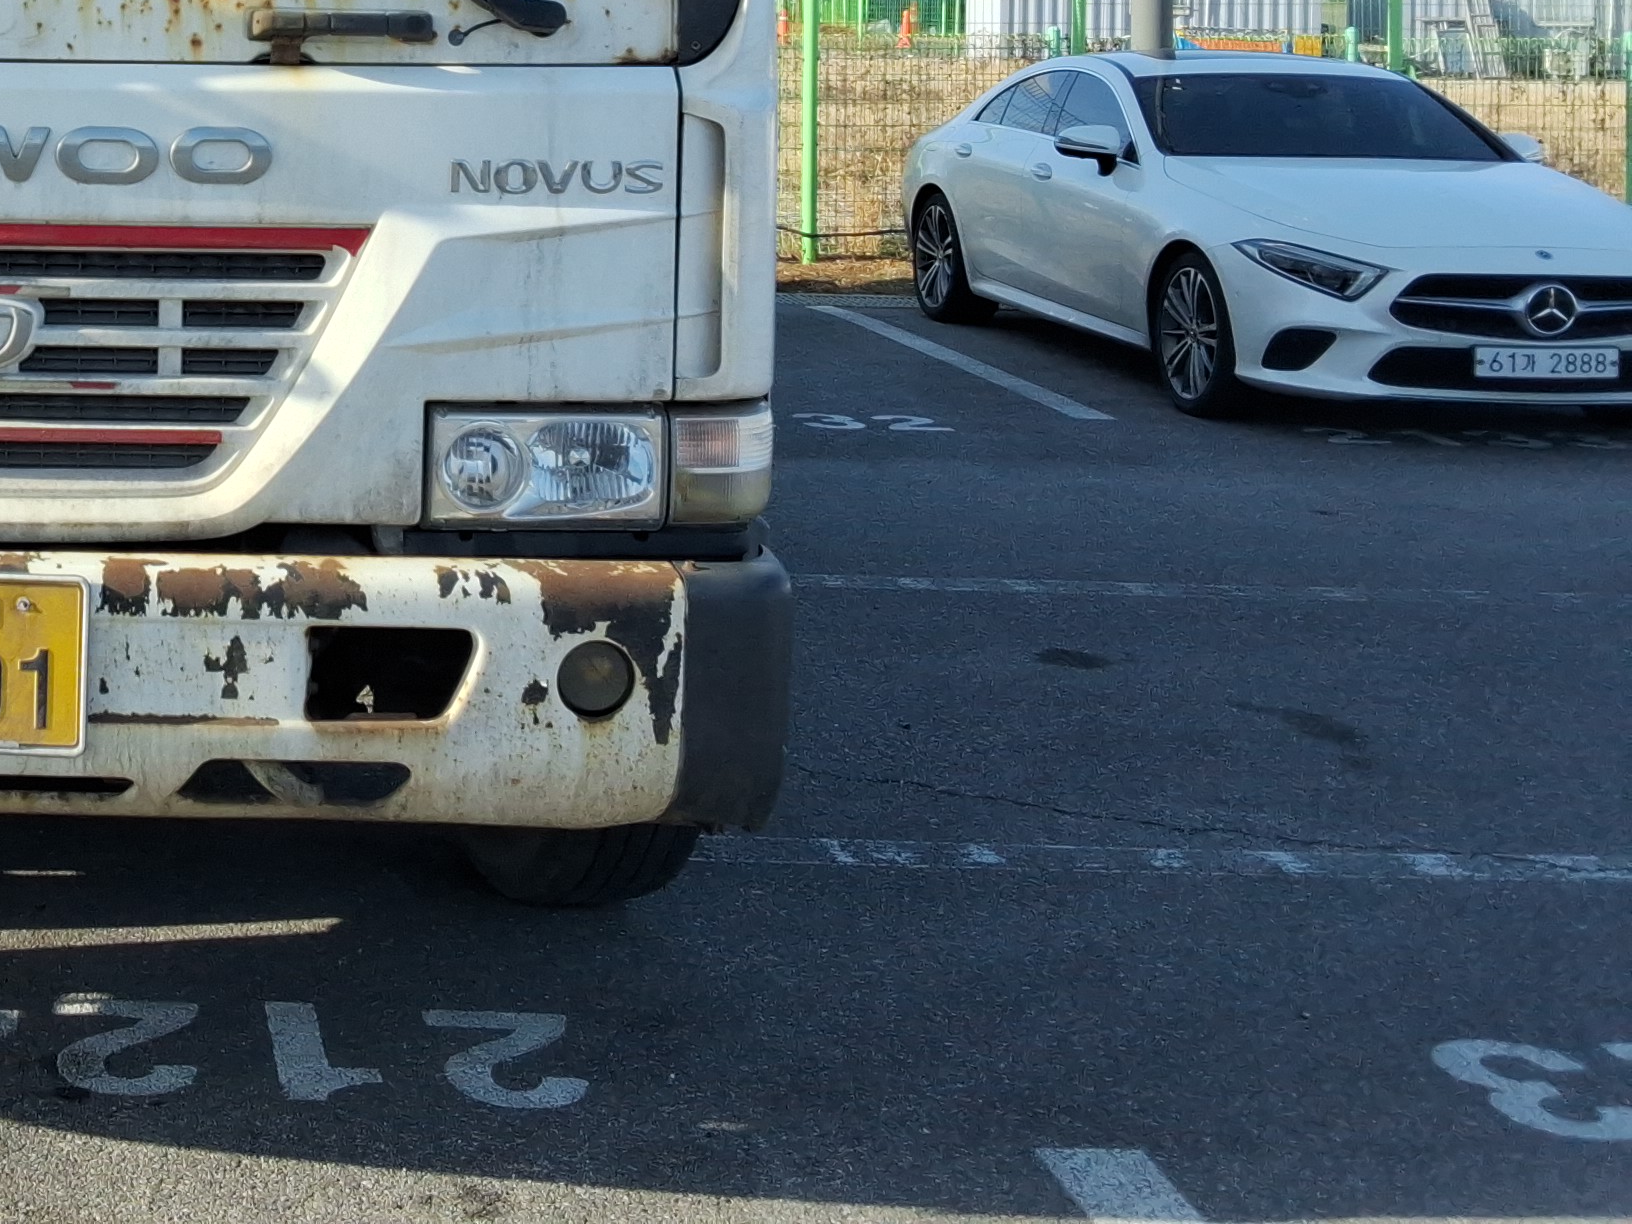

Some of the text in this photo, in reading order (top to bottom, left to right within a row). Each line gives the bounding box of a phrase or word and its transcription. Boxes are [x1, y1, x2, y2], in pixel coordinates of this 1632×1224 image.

[450, 158, 665, 196] NOVUS
[1489, 351, 1607, 374] 61가 2888
[792, 412, 956, 432] 32
